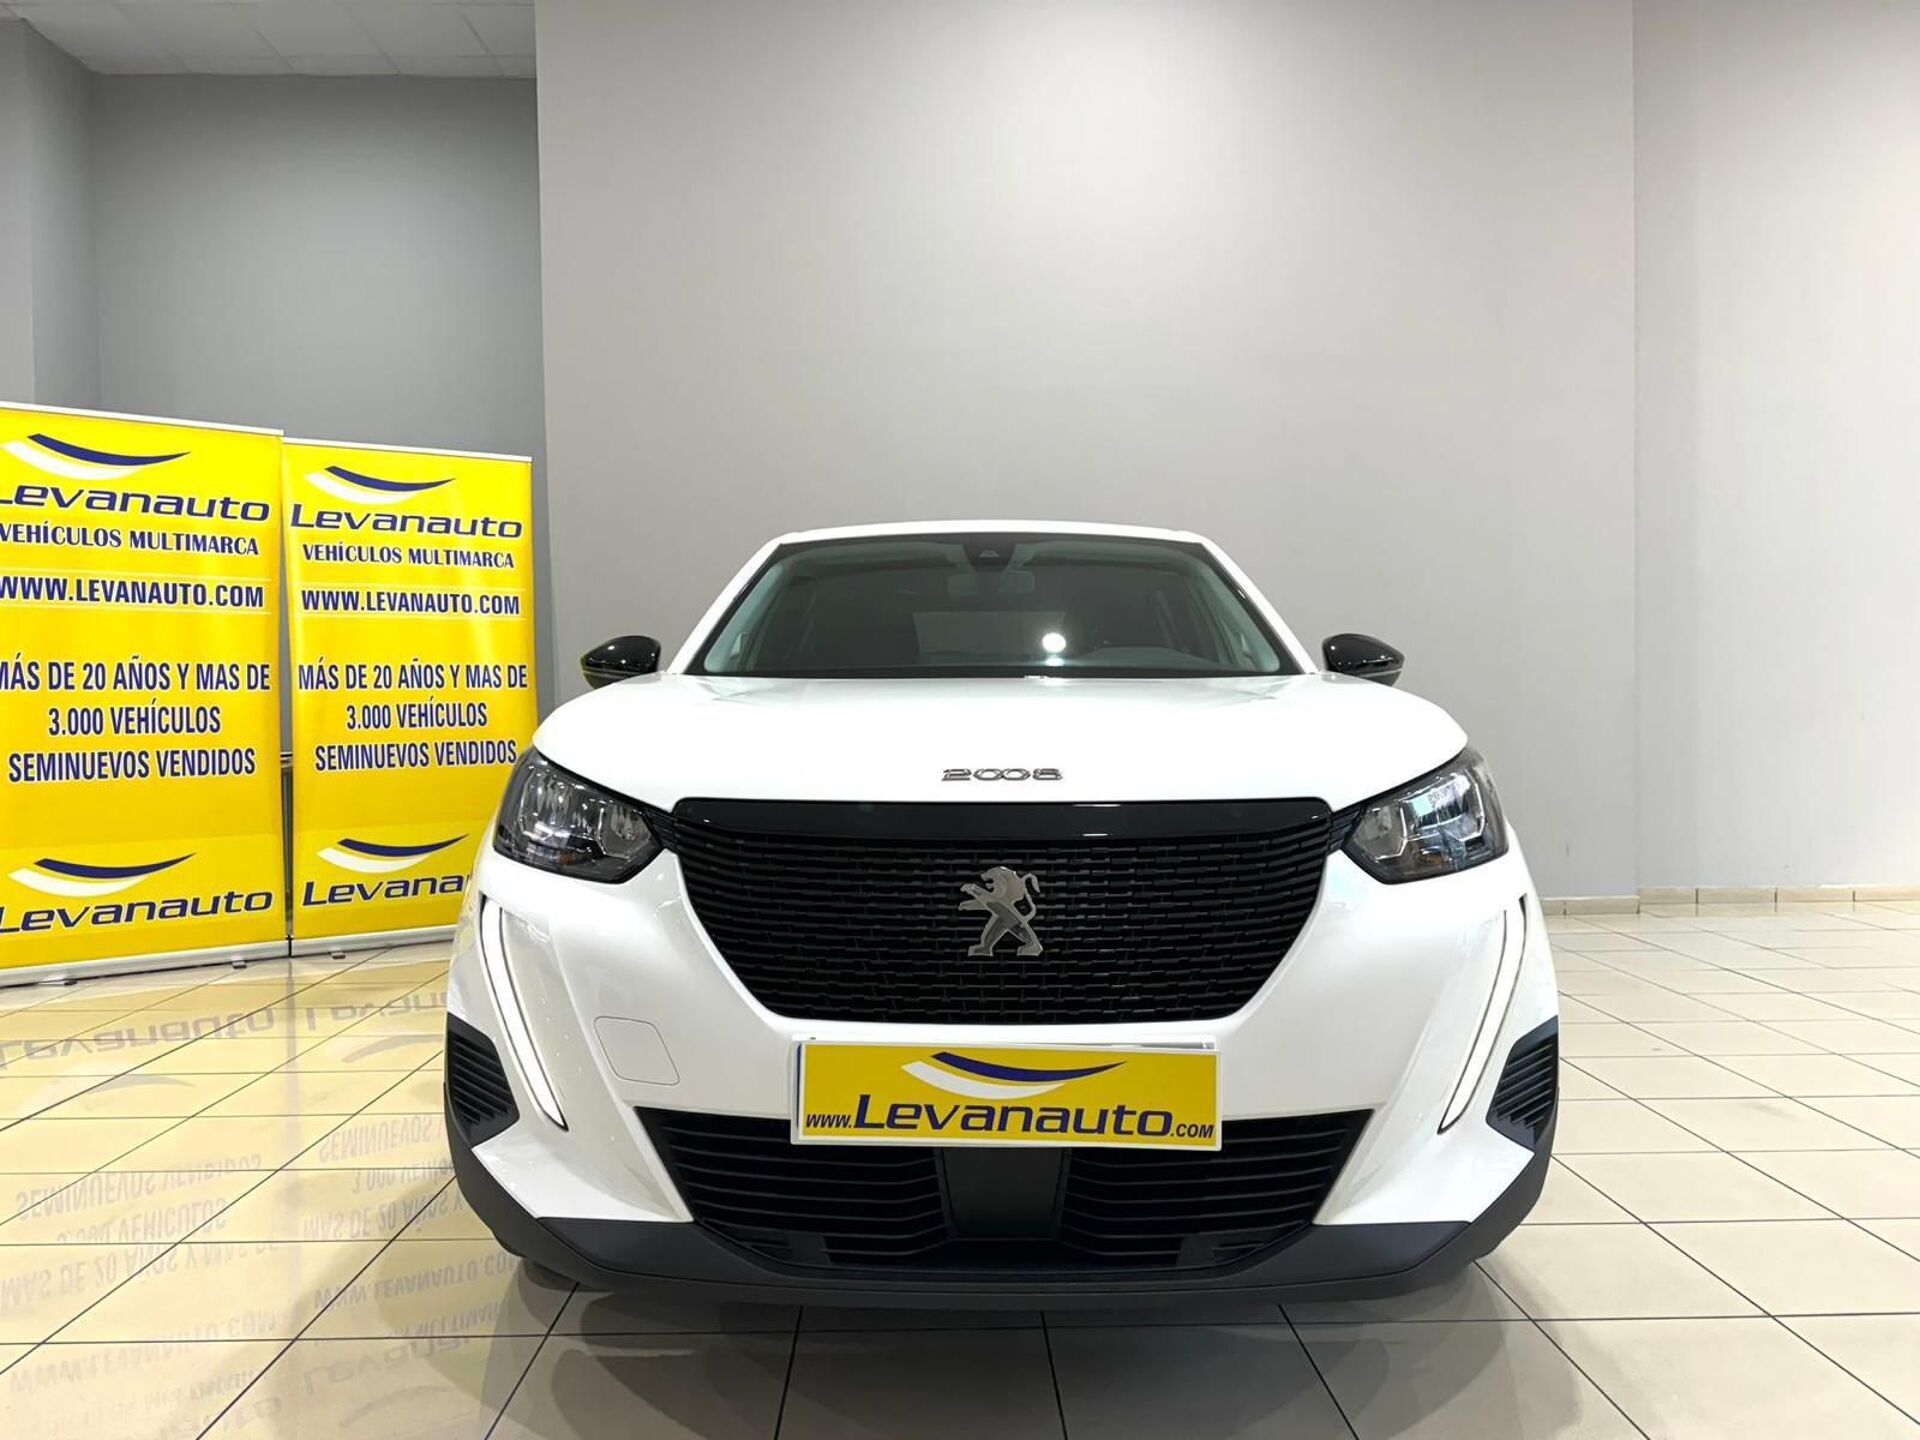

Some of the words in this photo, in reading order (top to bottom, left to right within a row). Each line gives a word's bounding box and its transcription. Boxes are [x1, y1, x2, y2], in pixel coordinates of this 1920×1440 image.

[291, 504, 522, 538] Levanauto
[0, 521, 122, 547] VEHÍCULOS
[130, 531, 259, 555] MULTIMARCA
[302, 542, 402, 563] VEHÍCULOS
[408, 548, 514, 568] MULTIMARCA
[0, 576, 264, 607] WWW.LEVANAUTO.COM
[301, 590, 519, 614] WWW.LEVANAUTO.COM
[49, 662, 75, 690] DE
[83, 663, 105, 690] 20
[113, 656, 170, 690] AÑOS
[177, 664, 189, 690] Y
[196, 664, 240, 690] MAS
[247, 664, 270, 690] DE
[298, 657, 339, 690] MÁS
[346, 665, 367, 689] DE
[374, 665, 392, 689] 20
[398, 659, 445, 689] AÑOS
[450, 665, 460, 689] Y
[466, 665, 501, 689] MAS
[508, 665, 528, 688] DE
[49, 708, 103, 735] 3.000
[110, 698, 221, 734] VEHÍCULOS
[347, 705, 391, 730] 3.000
[396, 696, 487, 728] VEHÍCULOS
[9, 751, 149, 782] SEMINUEVOS
[156, 748, 255, 777] VENDIDOS
[315, 743, 429, 771] SEMINUEVOS
[434, 740, 517, 766] VENDIDOS
[941, 768, 1063, 781] 2008
[302, 874, 470, 907] Levana
[0, 891, 272, 934] Levanauto
